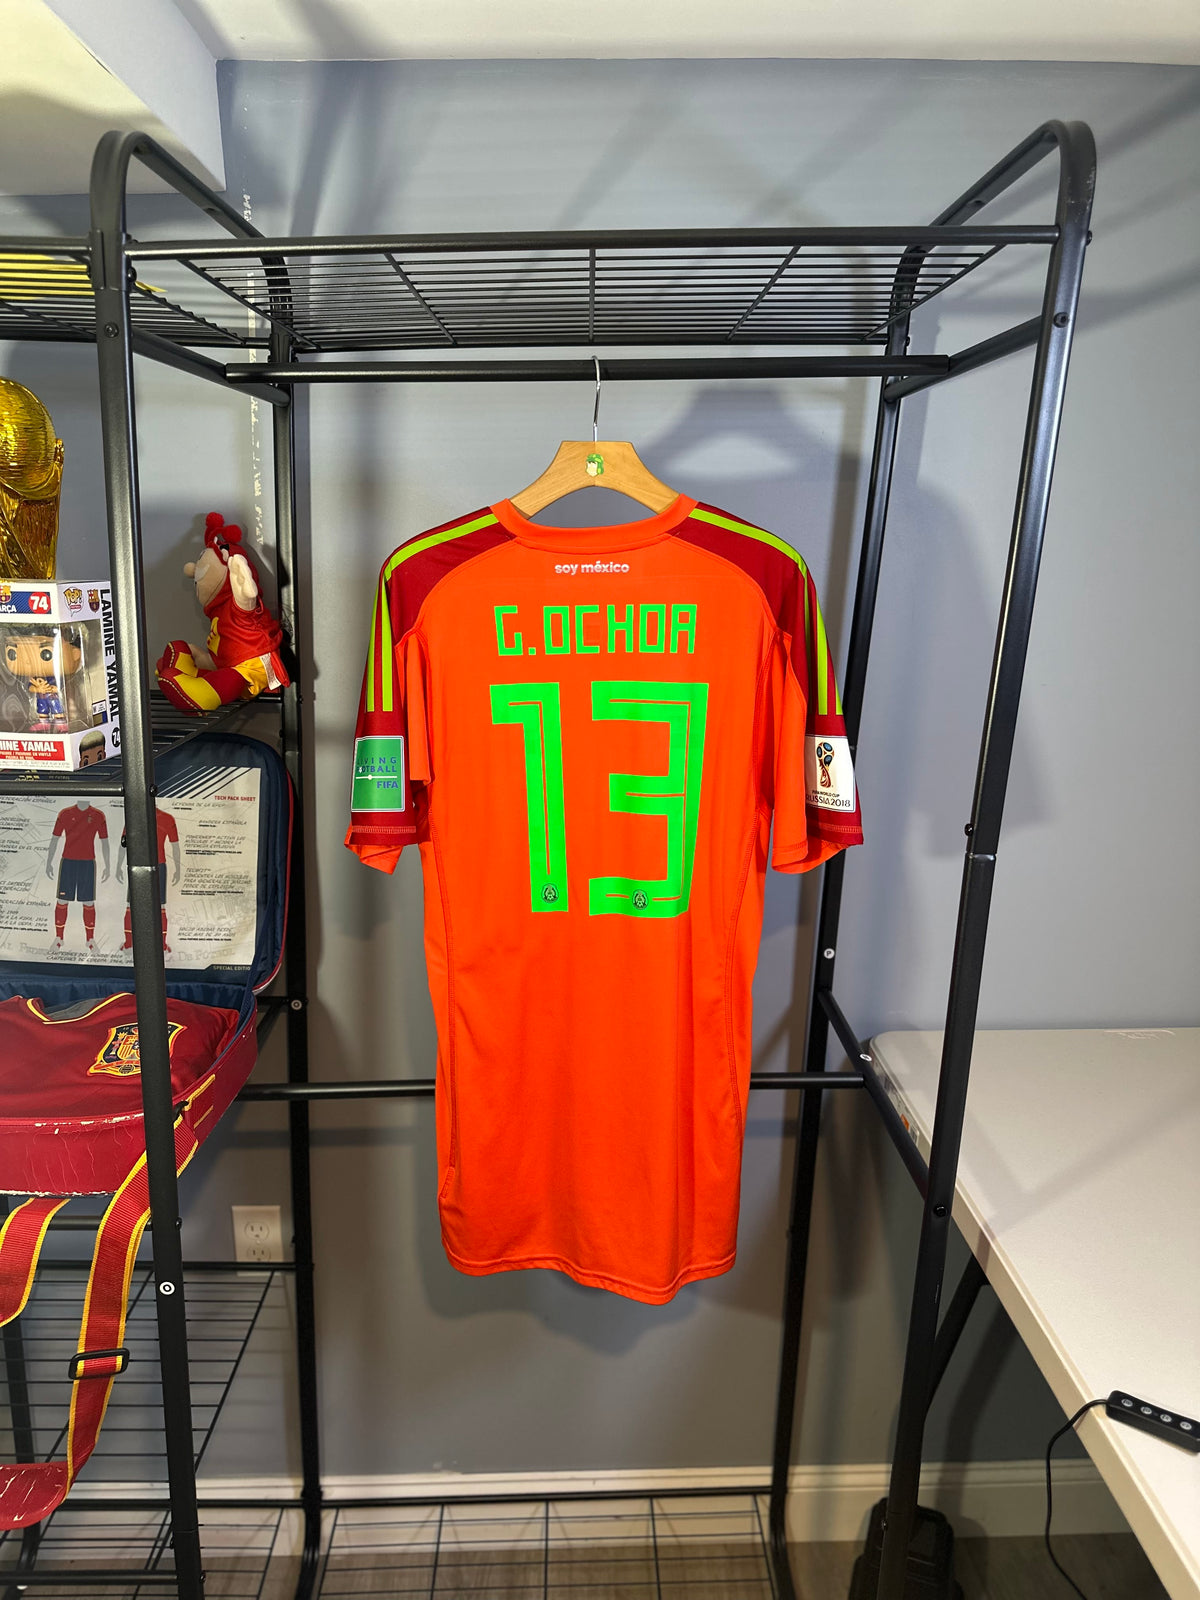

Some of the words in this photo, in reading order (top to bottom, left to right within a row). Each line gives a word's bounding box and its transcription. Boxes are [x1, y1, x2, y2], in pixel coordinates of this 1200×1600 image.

[554, 563, 579, 576] soy
[581, 560, 630, 573] méxico
[0, 604, 17, 614] RÇA
[30, 596, 49, 610] 74
[100, 589, 115, 657] LAMINE
[494, 604, 697, 656] G.OCHOA
[107, 662, 120, 722] YAMAL
[21, 741, 58, 752] YAMAL
[376, 781, 399, 789] FIFA
[489, 681, 709, 919] 13
[806, 794, 830, 805] RUSSIA
[830, 798, 851, 807] 2018
